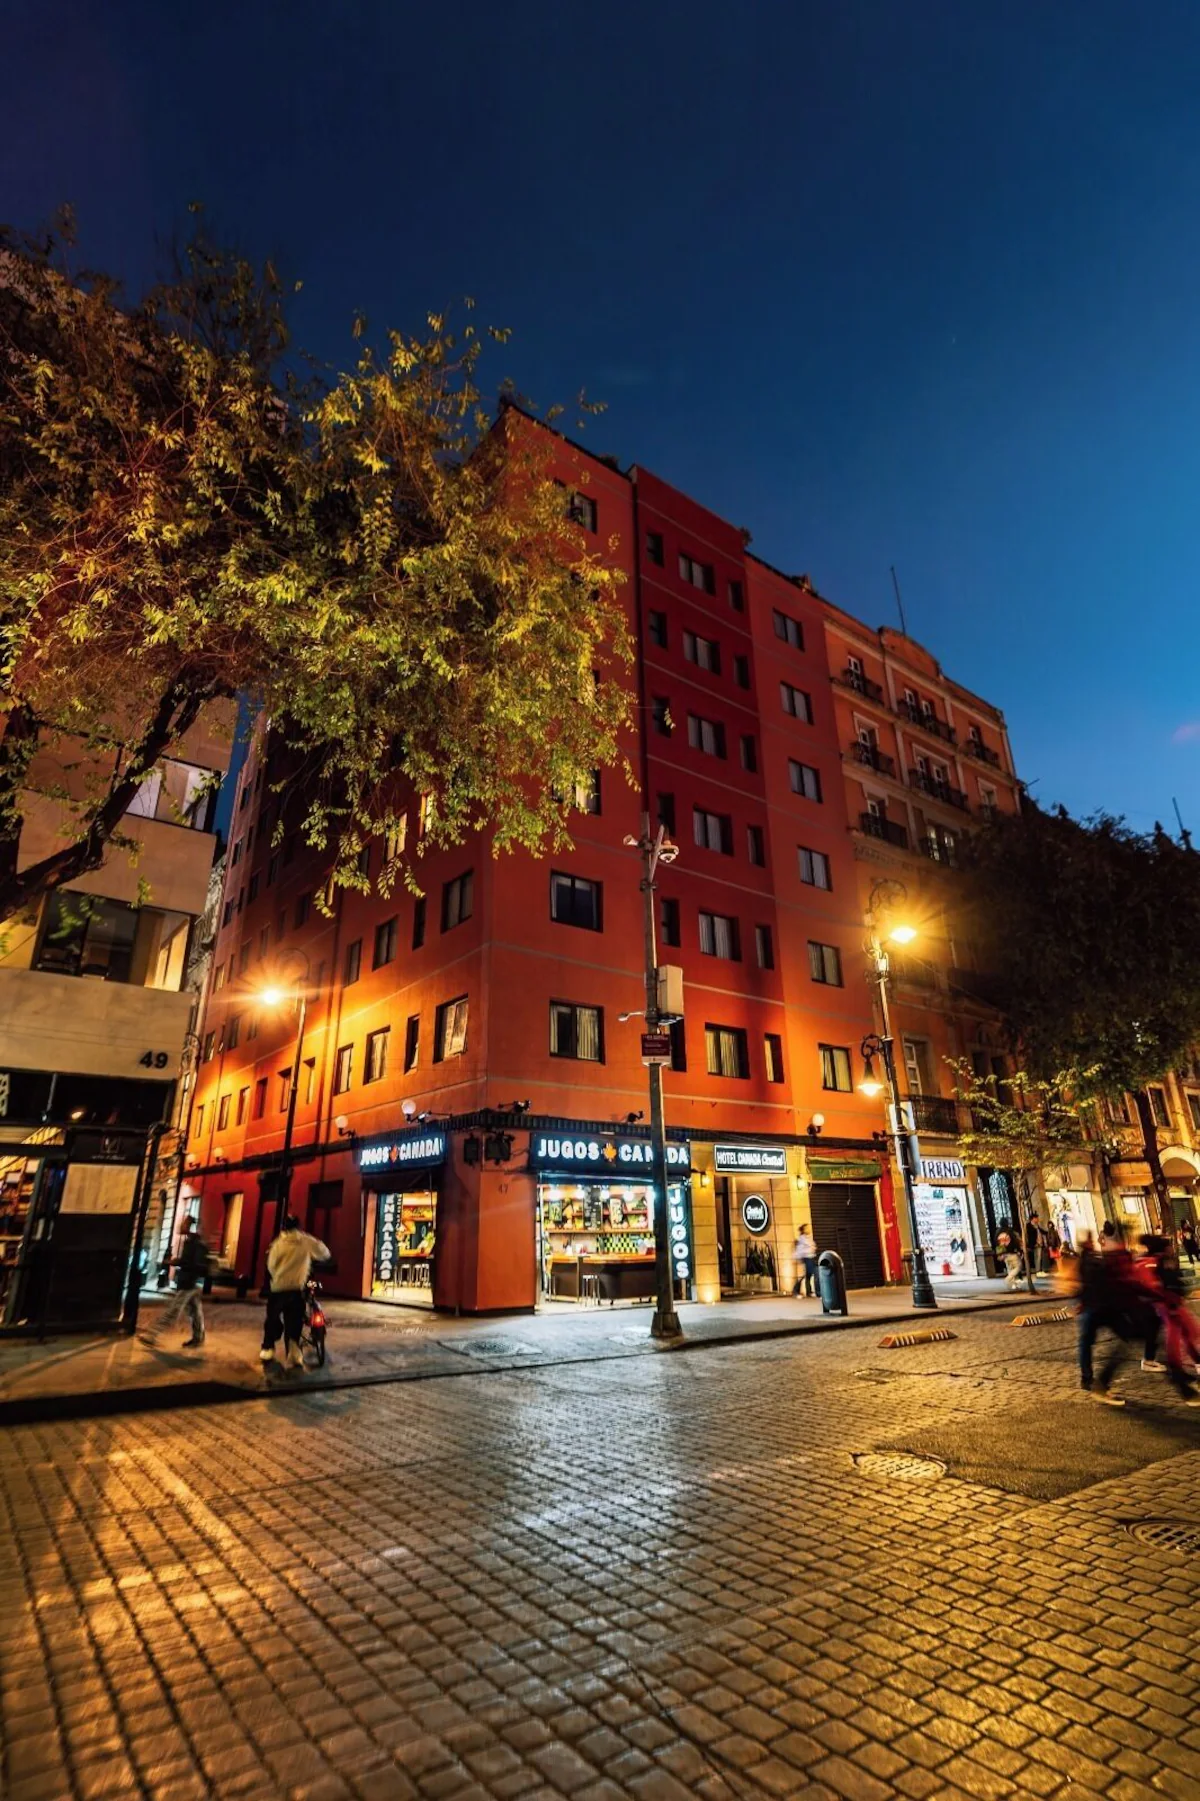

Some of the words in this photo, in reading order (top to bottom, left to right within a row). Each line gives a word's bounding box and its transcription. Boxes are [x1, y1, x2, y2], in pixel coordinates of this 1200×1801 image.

[139, 1050, 169, 1069] 49
[399, 1137, 440, 1161] CANADA
[538, 1139, 600, 1161] JUGOS
[619, 1144, 689, 1164] CANDA
[716, 1151, 737, 1165] HOTEL
[737, 1152, 762, 1166] CANADA
[379, 1193, 396, 1280] ENSALADAS
[669, 1187, 690, 1279] JUGOS
